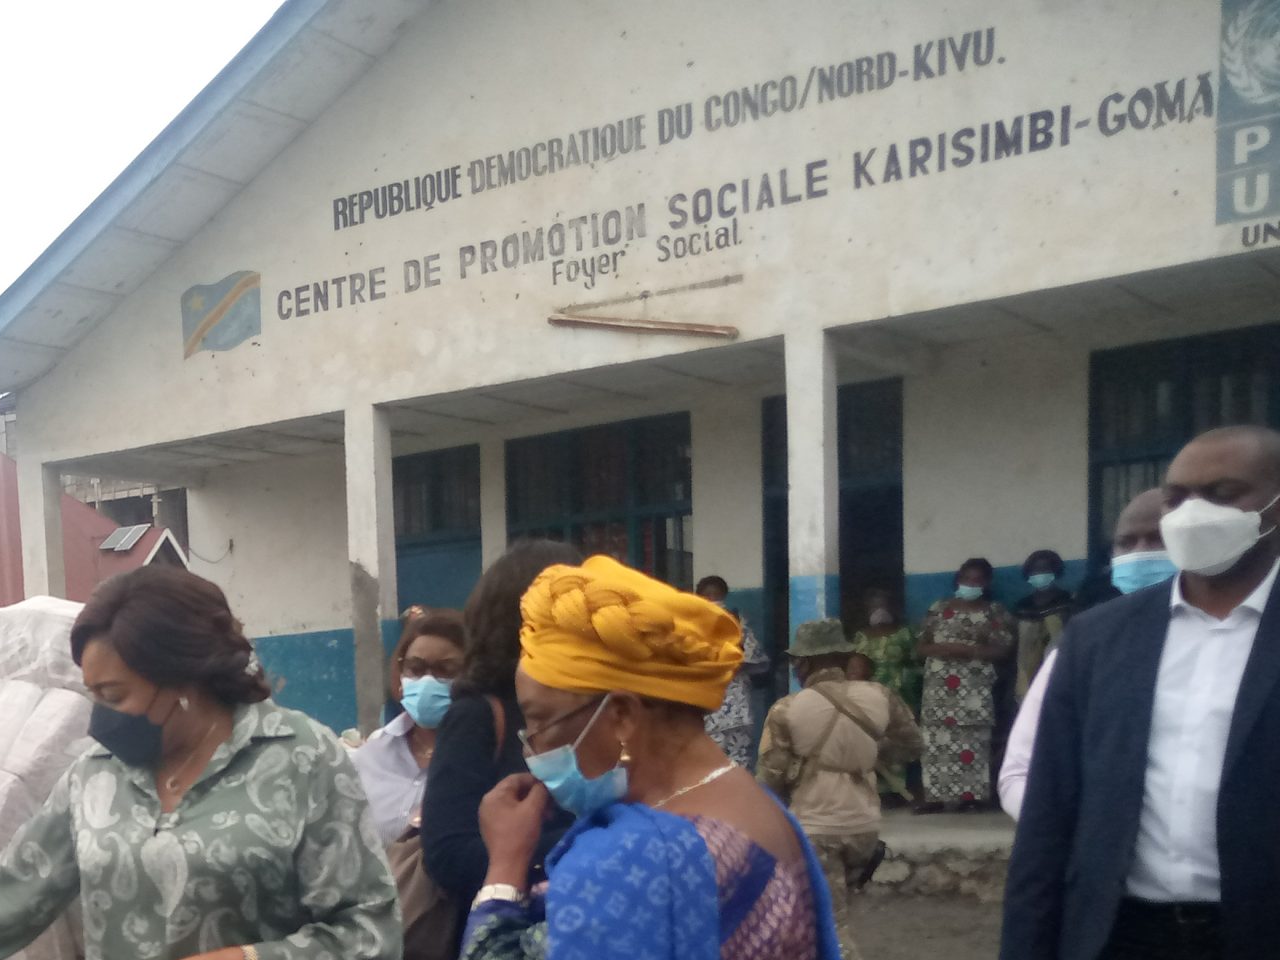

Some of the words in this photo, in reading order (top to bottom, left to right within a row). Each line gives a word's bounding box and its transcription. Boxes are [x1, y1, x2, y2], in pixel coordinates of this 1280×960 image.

[333, 165, 462, 231] REPUBLIQUE
[468, 115, 646, 196] DEMOCRATIQUE
[658, 102, 693, 146] DU
[704, 27, 1006, 131] CONGO/NORD-KIVU.
[1234, 125, 1270, 165] P
[277, 268, 386, 321] CENTRE
[404, 254, 441, 294] DE
[459, 203, 647, 279] PROMOTION
[668, 160, 828, 229] SOCIALE
[853, 71, 1214, 189] KARISIMBI-GOMA
[1233, 173, 1269, 213] U
[552, 249, 623, 290] Foyer
